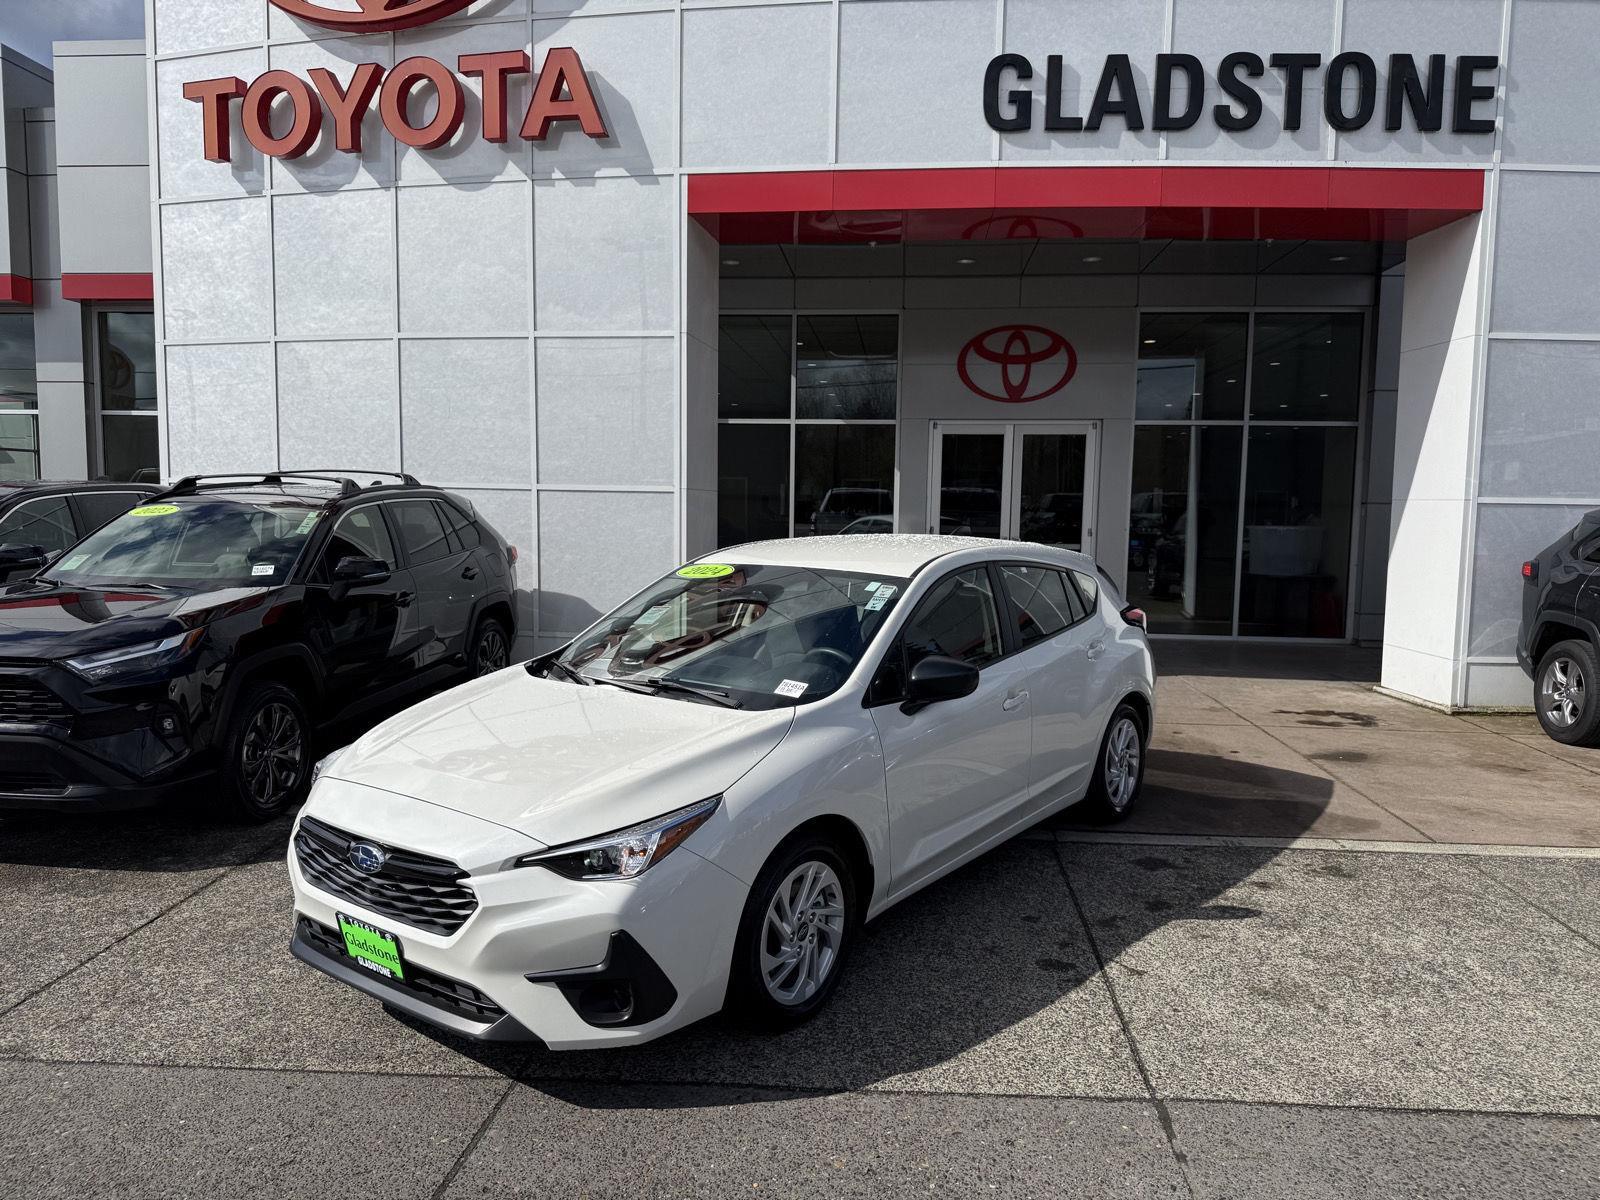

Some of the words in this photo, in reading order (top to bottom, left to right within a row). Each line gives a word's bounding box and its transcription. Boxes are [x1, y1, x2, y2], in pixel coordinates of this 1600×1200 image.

[183, 47, 609, 163] TOYOTA
[983, 51, 1499, 134] GLADSTONE
[682, 566, 728, 576] 2024
[348, 918, 381, 936] TOYOTA
[344, 931, 400, 965] Gladstone
[357, 956, 392, 978] GLADSTONE
